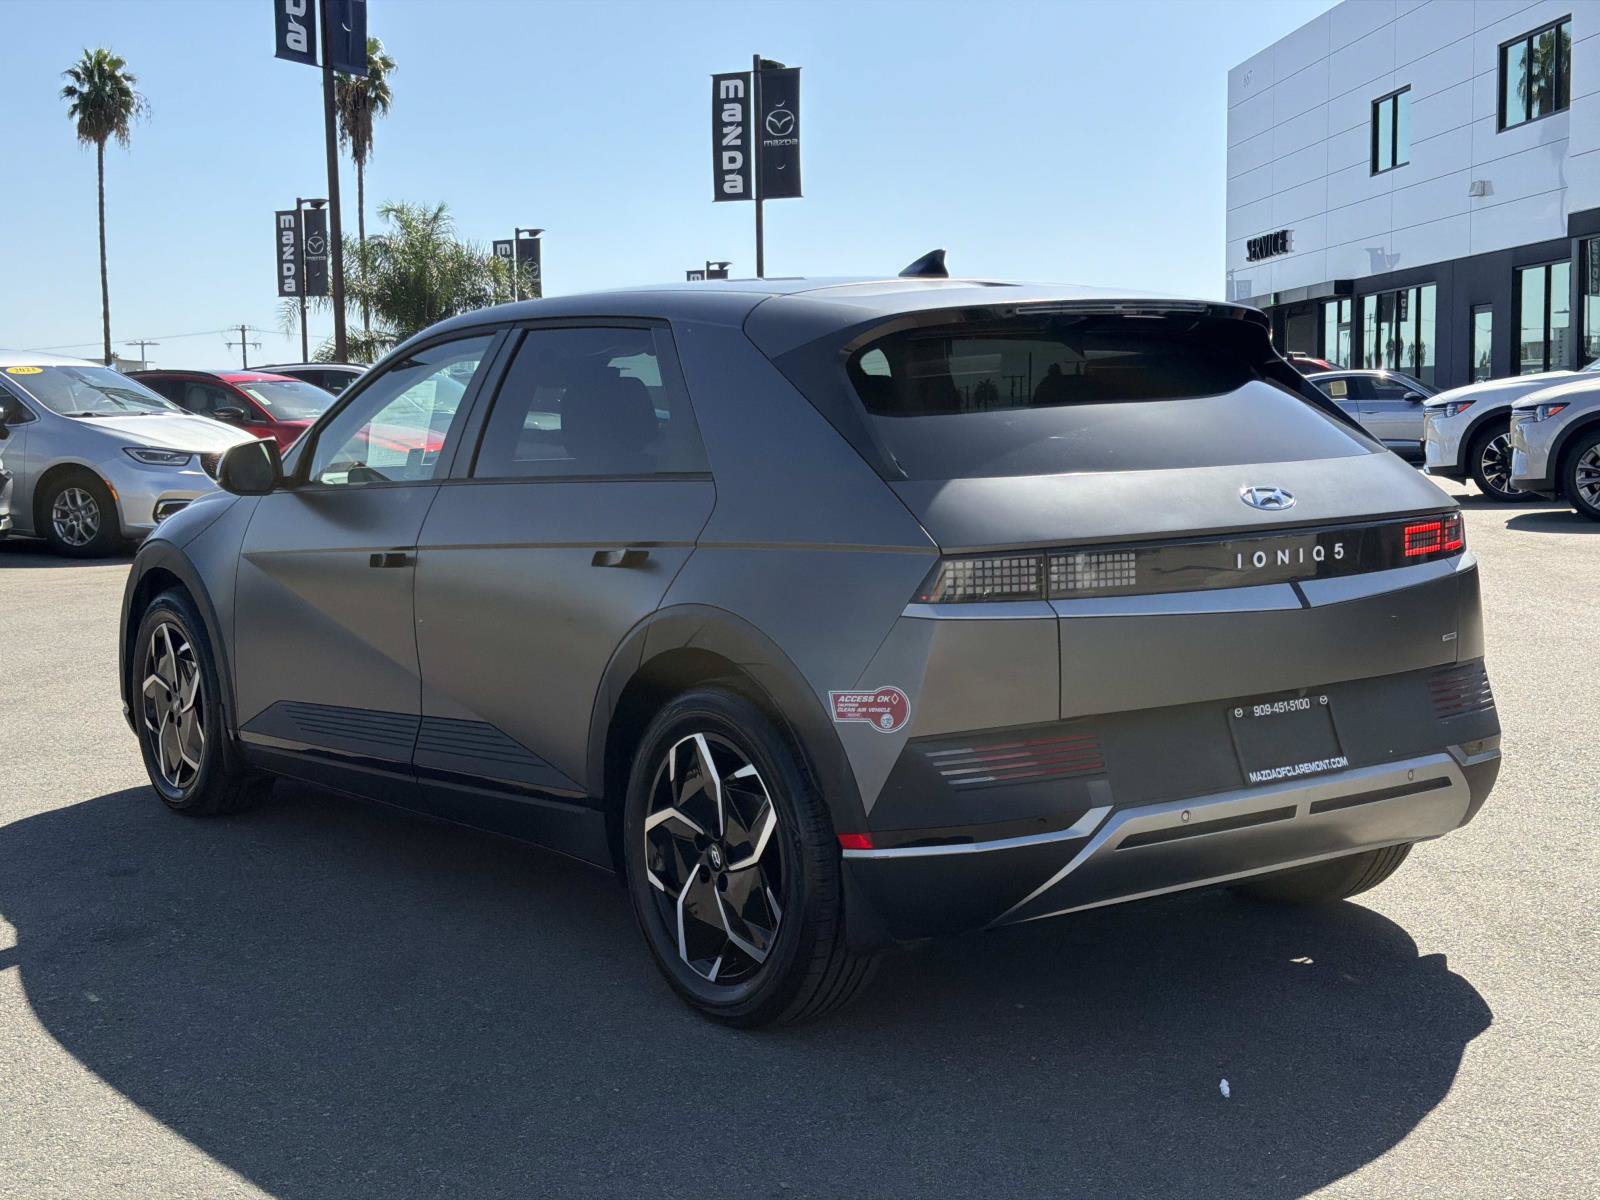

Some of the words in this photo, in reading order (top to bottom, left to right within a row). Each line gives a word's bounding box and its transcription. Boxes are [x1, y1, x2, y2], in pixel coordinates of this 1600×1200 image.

[1246, 230, 1294, 262] SERVICE
[838, 695, 875, 703] ACCESS
[877, 695, 891, 703] OK
[1253, 698, 1310, 717] 909-451-5100
[1249, 756, 1349, 783] MAZDAOFCLAREMONT.COM
